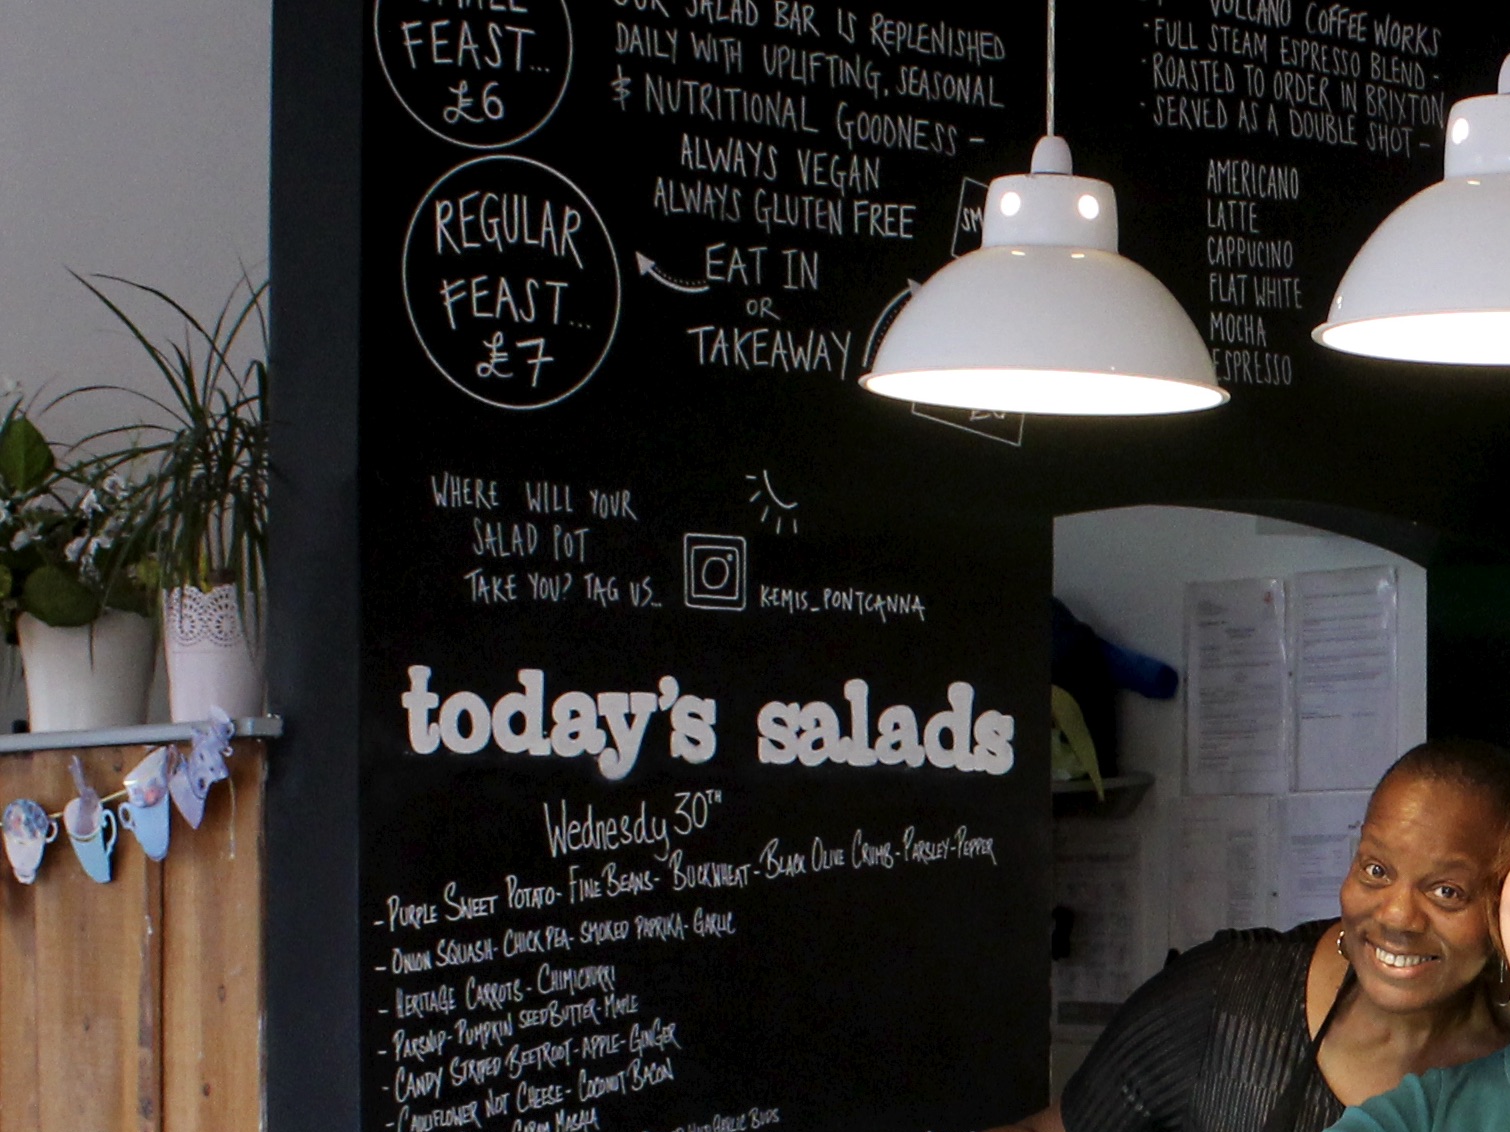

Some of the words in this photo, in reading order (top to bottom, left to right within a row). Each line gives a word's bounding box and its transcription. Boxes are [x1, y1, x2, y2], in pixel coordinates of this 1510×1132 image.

[774, 0, 820, 37] BAR
[838, 8, 857, 43] IS
[870, 12, 1006, 65] REPLENISHED
[1155, 19, 1198, 49] FULL
[1208, 24, 1267, 62] STEAM
[1280, 35, 1361, 77] ESPRESSO
[1370, 52, 1426, 90] BLEND
[1305, 1, 1368, 42] COFFEE
[1374, 13, 1441, 56] WORKS
[616, 22, 678, 63] DAILY
[691, 32, 743, 74] WITH
[900, 65, 1004, 107] SEASONAL
[1153, 52, 1235, 93] ROASTED
[1244, 64, 1265, 98] TO
[1273, 70, 1331, 112] ORDER
[1341, 80, 1357, 112] IN
[1365, 84, 1445, 129] BRIXTON
[443, 80, 504, 123] £6
[645, 74, 818, 133] NUTRITIONAL
[837, 102, 957, 156] GOODNESS
[1153, 96, 1228, 130] SERVED
[1238, 101, 1259, 133] AS
[1268, 103, 1279, 136] A
[1289, 108, 1358, 146] DOUBLE
[1367, 122, 1413, 157] SHOT
[681, 133, 777, 180] ALWAYS
[798, 149, 880, 197] VEGAN
[1207, 158, 1299, 200] AMERICANO
[435, 191, 583, 269] REGULAR
[654, 177, 740, 221] ALWAYS
[756, 188, 842, 235] GLUTEN
[854, 200, 917, 239] FREE
[1207, 198, 1260, 233] LATTE
[706, 242, 768, 285] EAT
[782, 249, 818, 290] IN
[1207, 235, 1293, 269] CAPPUCINO
[746, 297, 781, 320] OR
[1209, 273, 1248, 305] FLAT
[1254, 275, 1302, 309] WHITE
[687, 326, 851, 380] TAKEAWAY
[1210, 311, 1267, 347] MOCHA
[476, 331, 554, 387] £7
[430, 471, 499, 509] WHERE
[526, 481, 574, 514] WILL
[589, 489, 638, 521] YOUR
[472, 517, 538, 558] SALAD
[553, 526, 590, 562] POT
[464, 568, 517, 603] TAKE
[528, 572, 572, 602] YOU?
[584, 573, 620, 608] TAG
[402, 665, 717, 780] today's
[757, 678, 1014, 775] salads
[543, 799, 669, 861] Wednesdy
[387, 894, 437, 932] PURPLE
[444, 881, 499, 921] SWEET
[569, 865, 602, 904] FINE
[811, 836, 845, 872] OLIVE
[396, 984, 456, 1018] HERITAGE
[395, 1066, 443, 1102] CANDY
[485, 1088, 510, 1117] NOT
[627, 1057, 674, 1091] BACON
